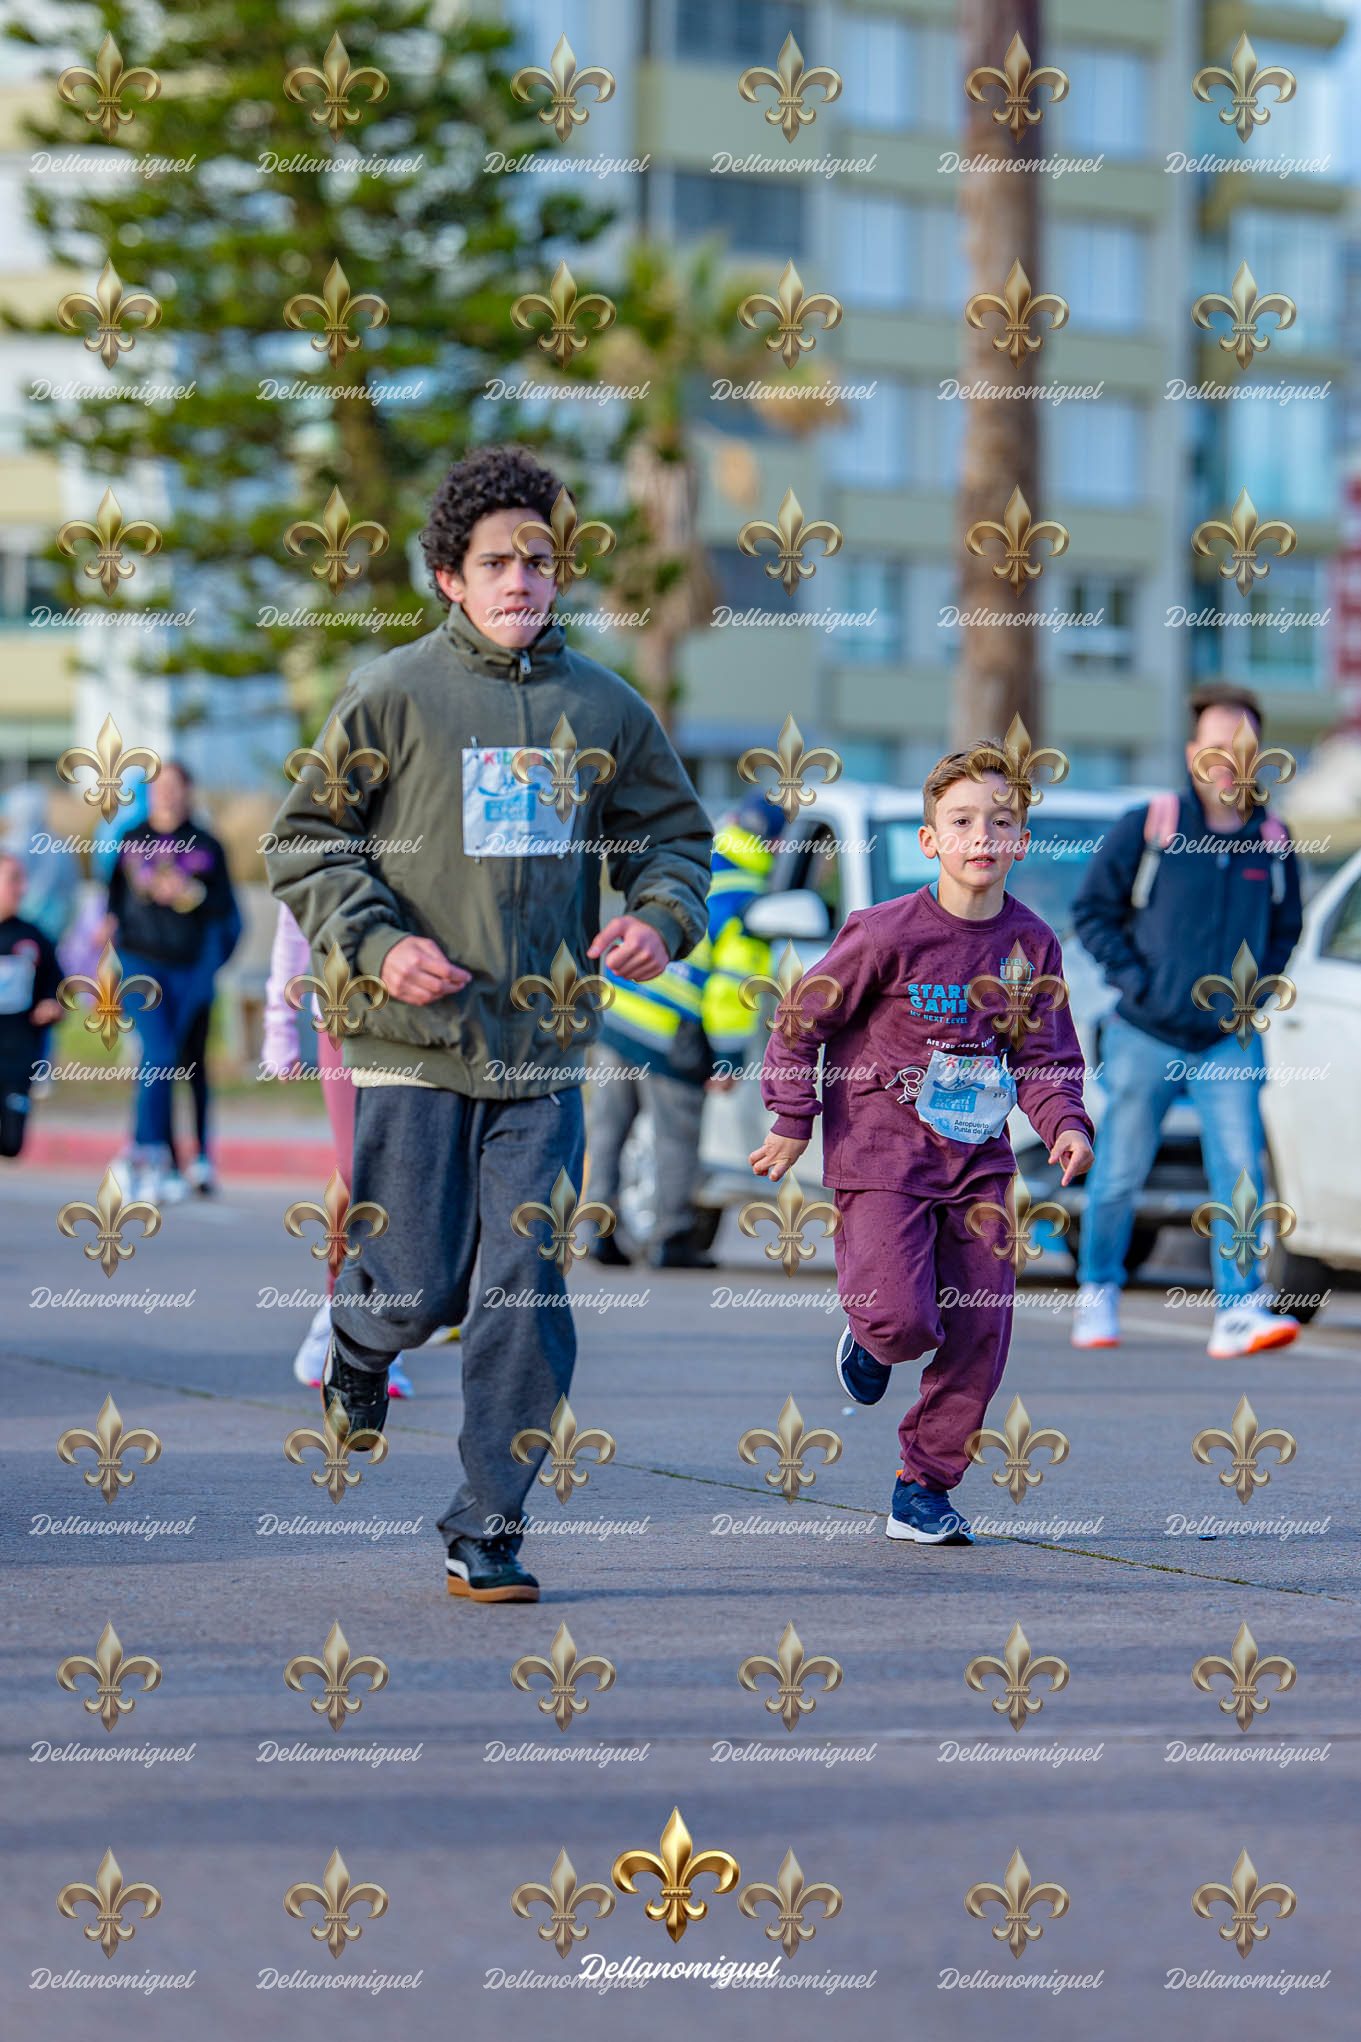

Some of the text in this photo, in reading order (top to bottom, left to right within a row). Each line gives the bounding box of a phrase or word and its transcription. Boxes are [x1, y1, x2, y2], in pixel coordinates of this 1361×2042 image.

[1000, 965, 1023, 980] UP
[907, 984, 972, 998] START
[910, 995, 968, 1013] GAME
[923, 1014, 944, 1023] NEXT
[926, 1038, 940, 1047] Are
[954, 1120, 989, 1129] Aeropuerto
